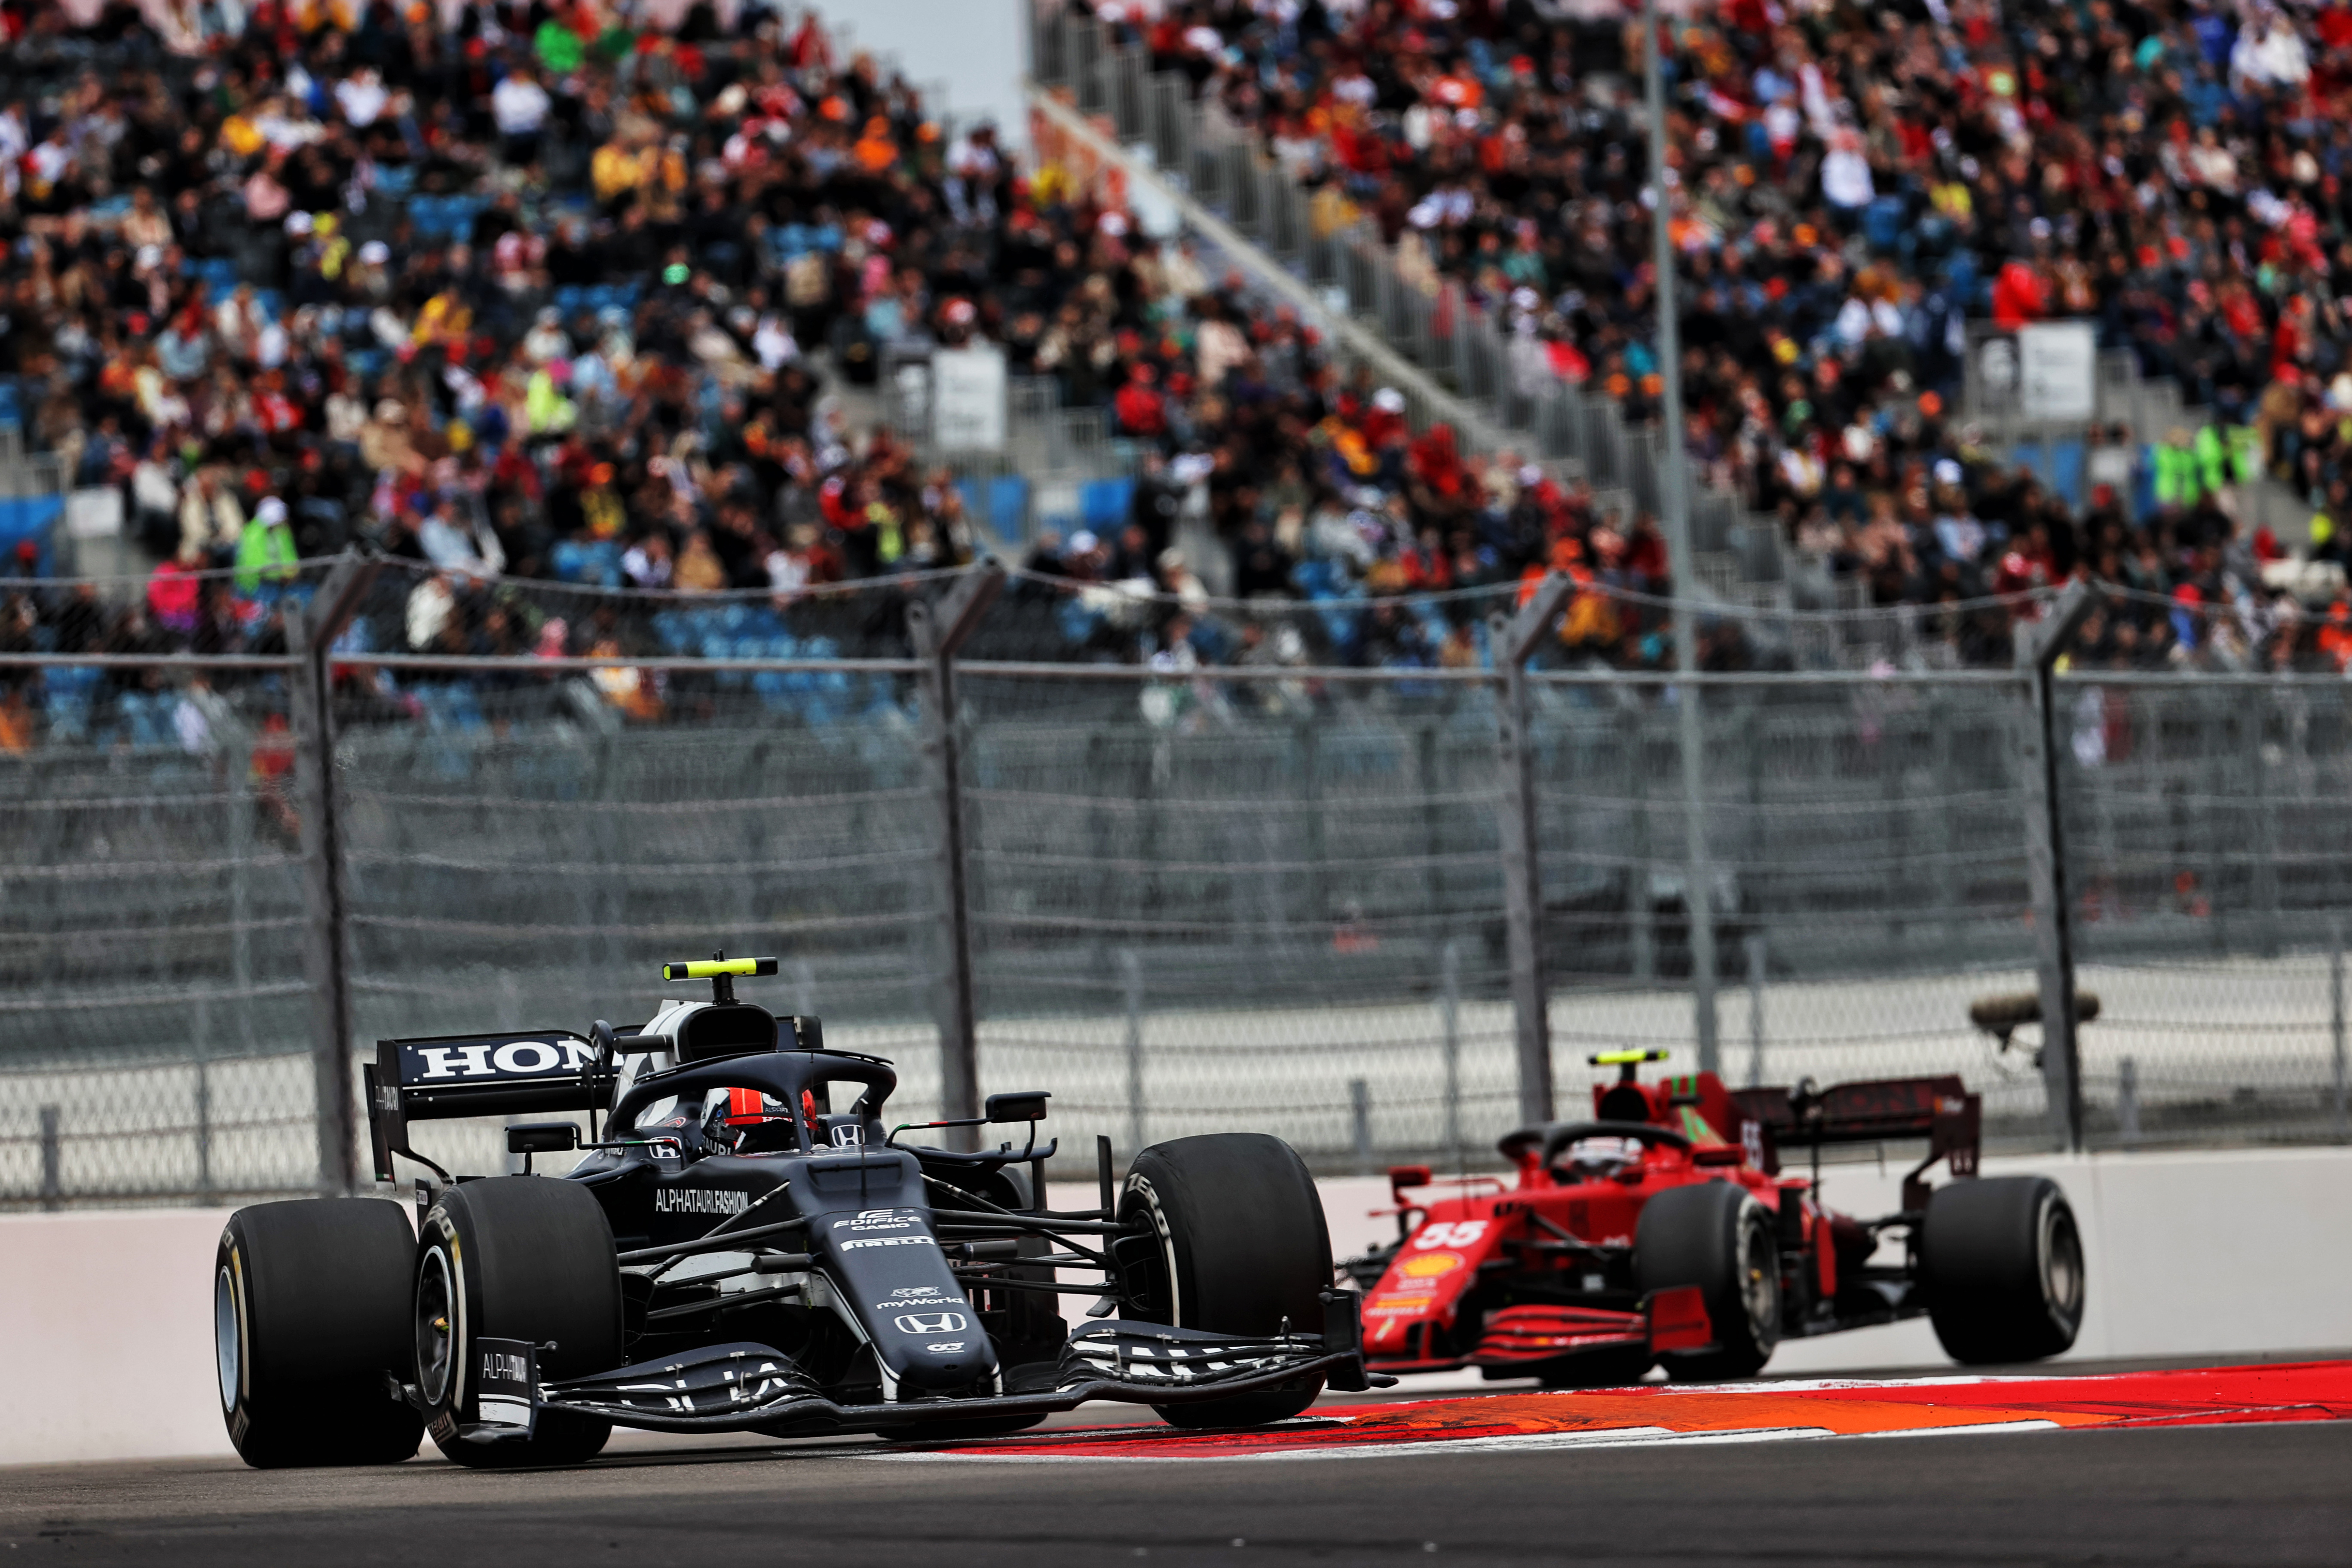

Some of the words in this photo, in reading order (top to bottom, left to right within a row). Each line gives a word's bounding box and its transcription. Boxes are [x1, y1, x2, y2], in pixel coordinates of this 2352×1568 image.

[418, 1041, 625, 1078] HON
[833, 1216, 922, 1228] EDIFICE
[1414, 1219, 1489, 1250] 55
[840, 1236, 935, 1251] PIRELLI
[876, 1297, 965, 1309] myWorld
